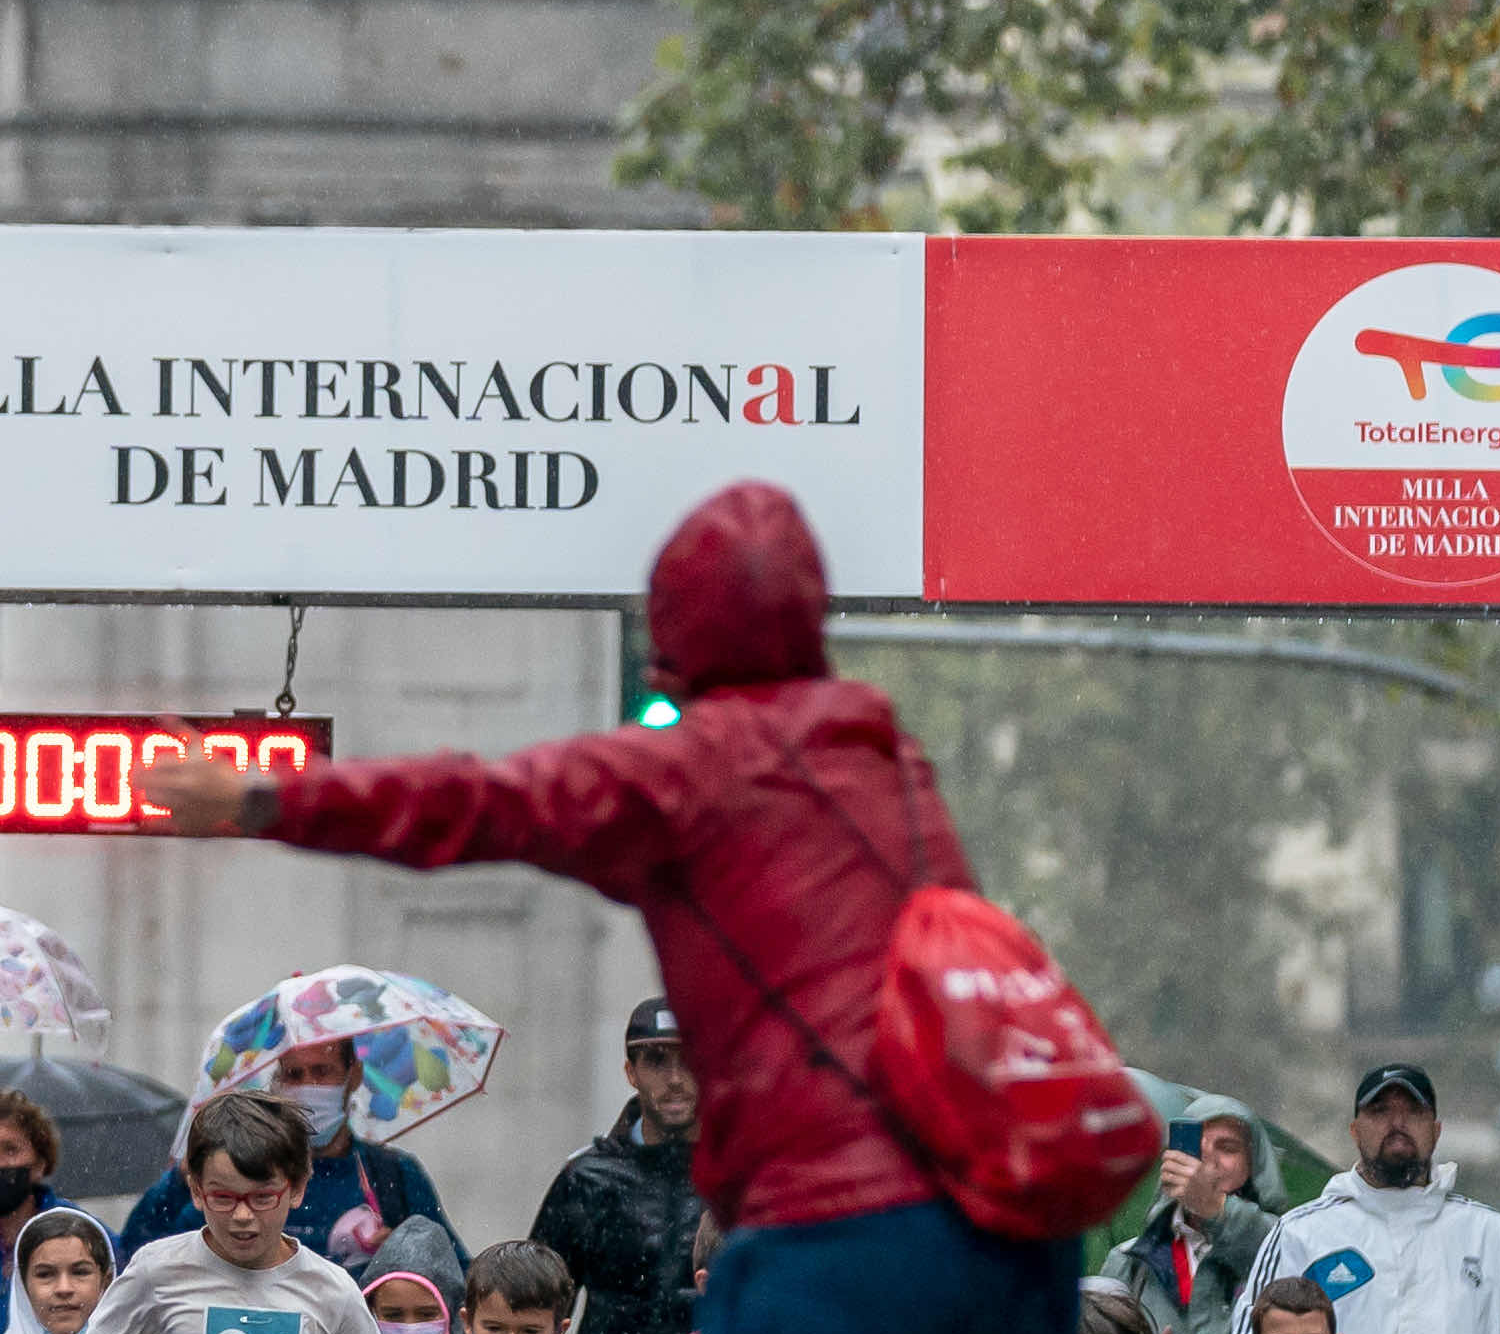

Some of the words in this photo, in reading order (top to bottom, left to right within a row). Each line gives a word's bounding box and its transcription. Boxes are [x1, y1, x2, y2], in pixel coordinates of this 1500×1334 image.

[110, 445, 228, 508] DE
[252, 447, 601, 512] MADRID
[1401, 477, 1490, 501] MILLA
[1367, 533, 1406, 557] DE
